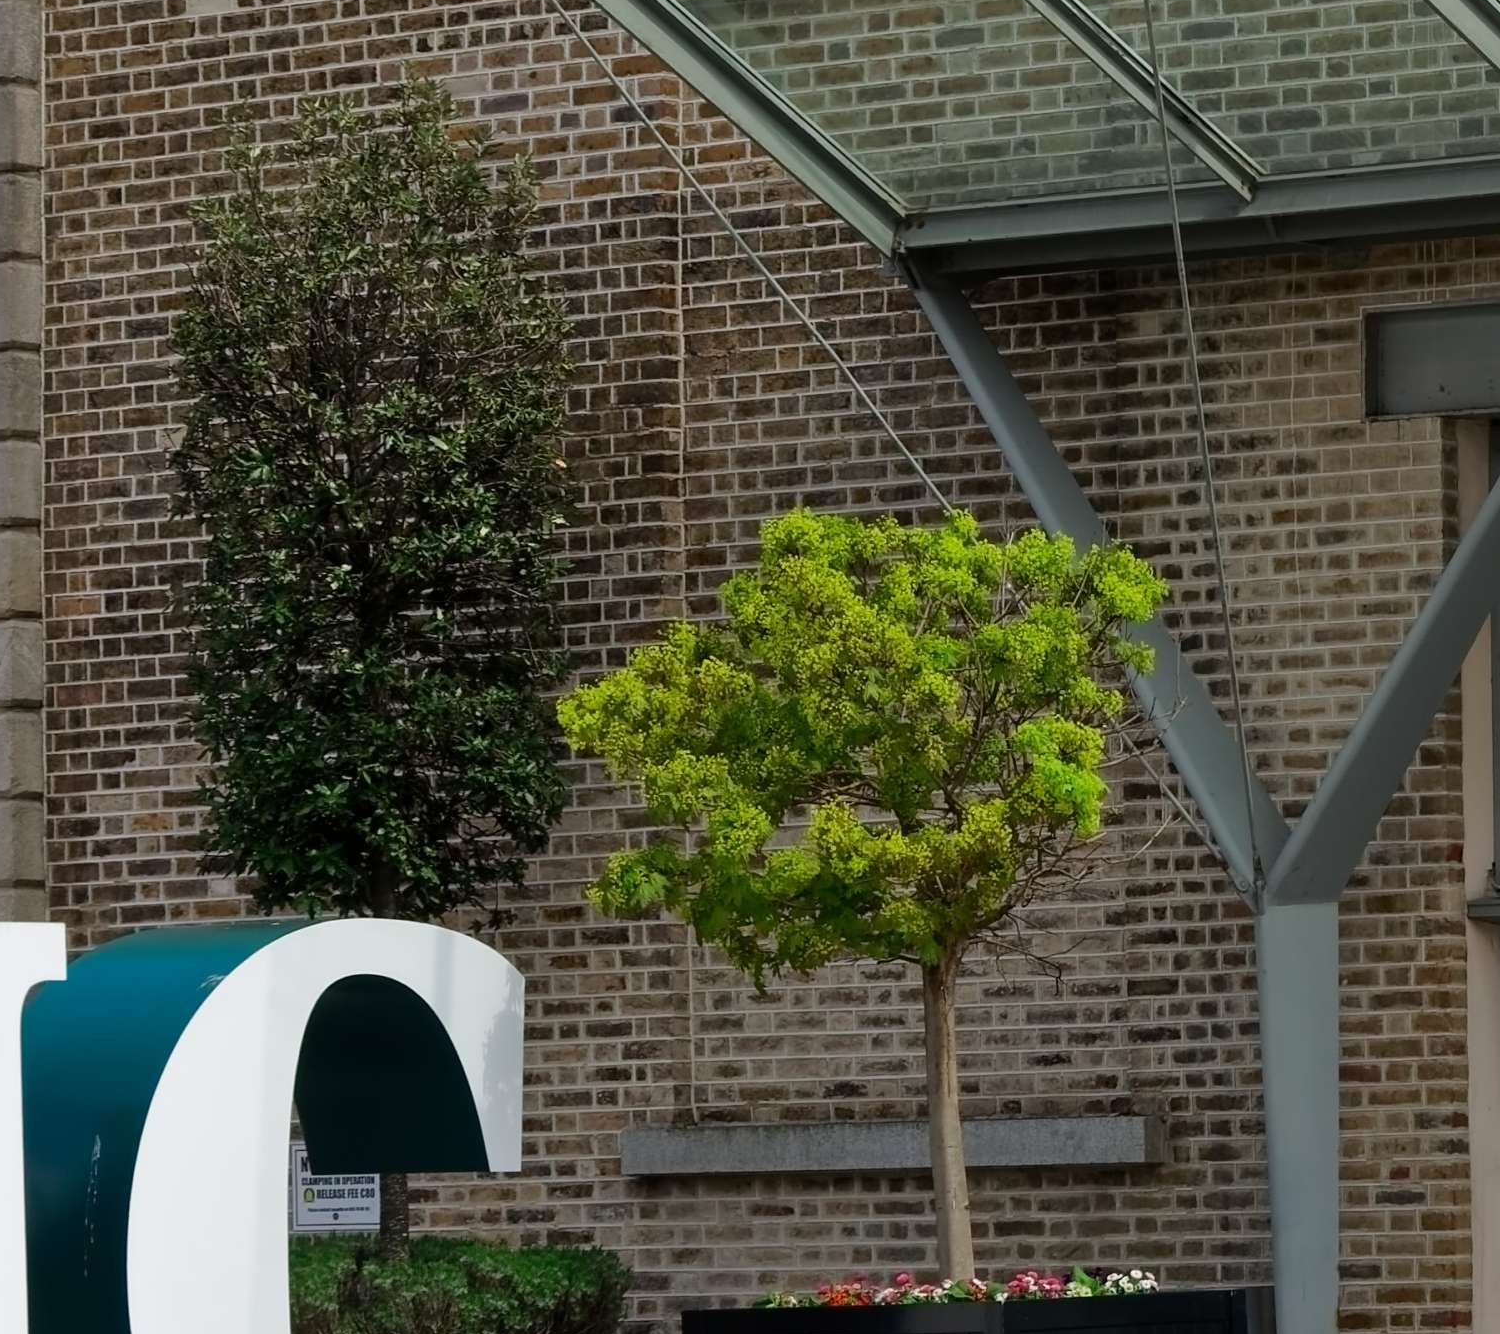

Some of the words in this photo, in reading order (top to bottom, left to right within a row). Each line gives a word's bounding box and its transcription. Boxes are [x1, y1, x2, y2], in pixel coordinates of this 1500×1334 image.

[301, 1177, 332, 1186] CLAMPING
[342, 1176, 375, 1185] OPERATION
[316, 1189, 346, 1199] RELEASE
[347, 1188, 359, 1198] FEE
